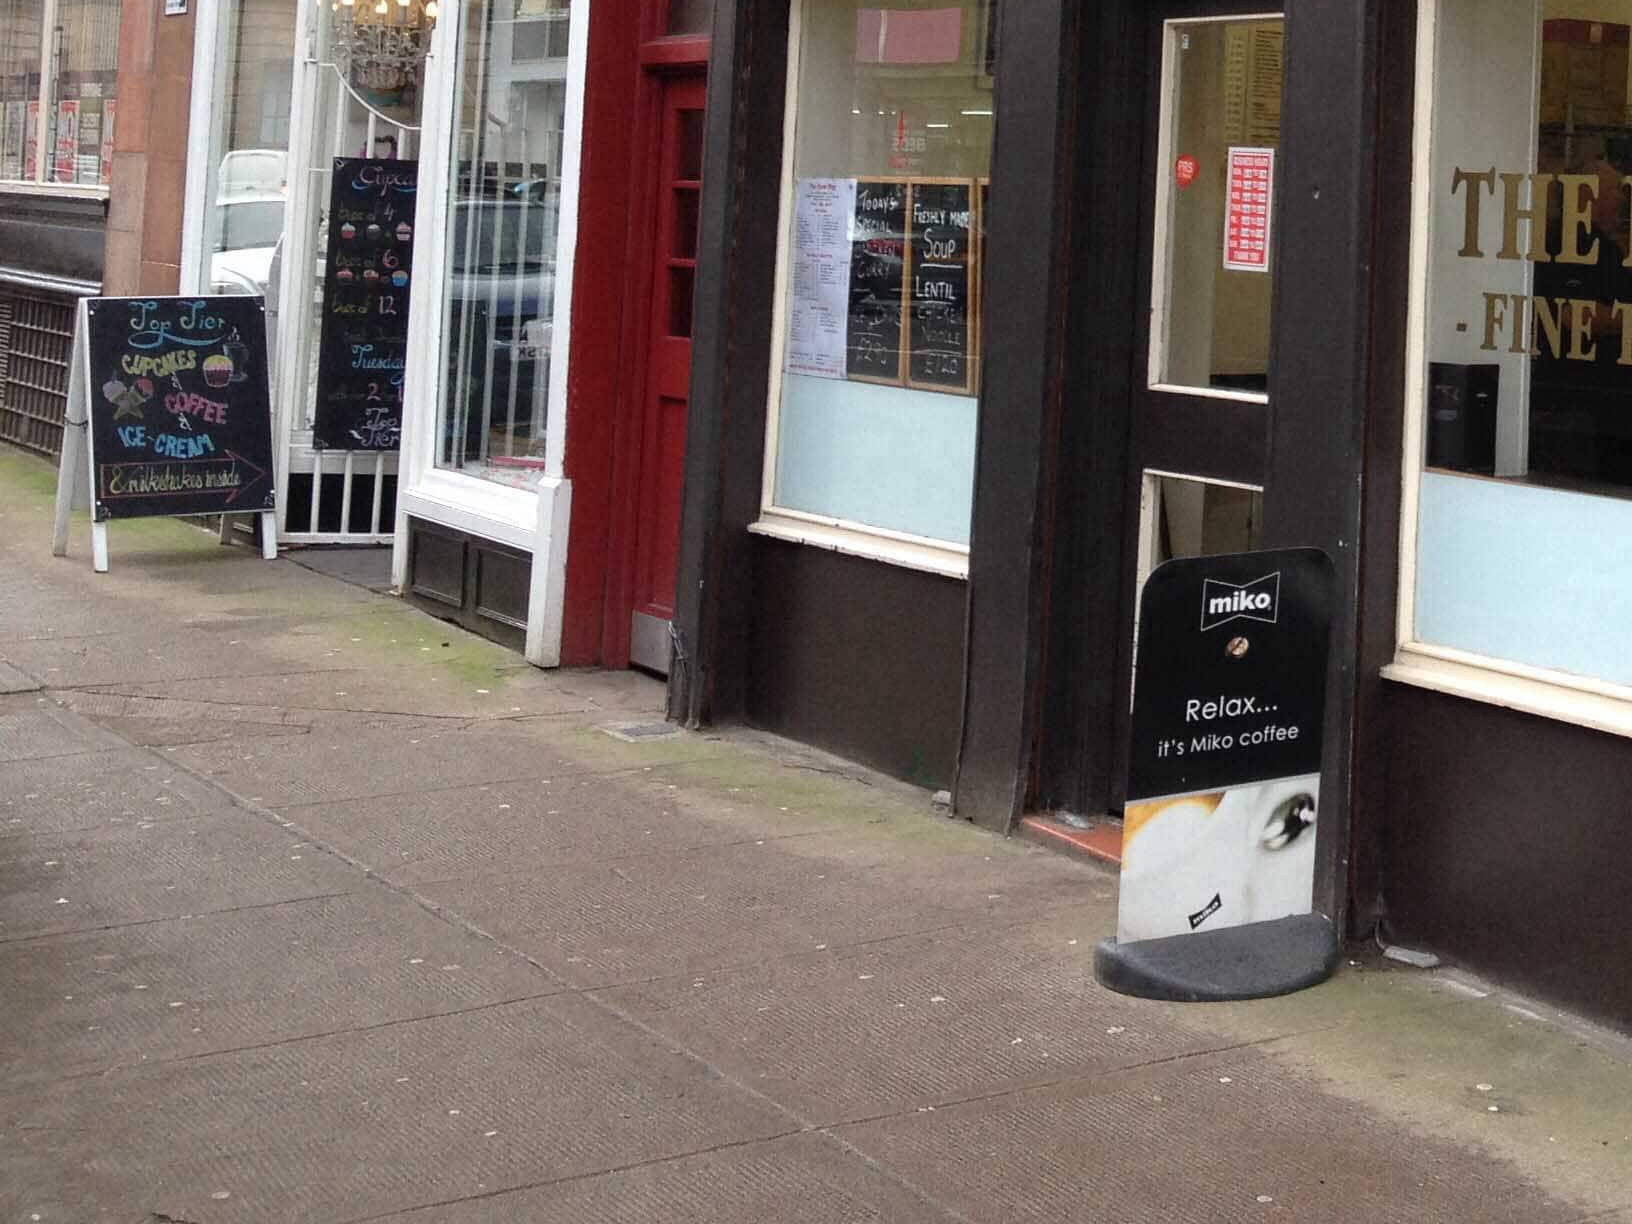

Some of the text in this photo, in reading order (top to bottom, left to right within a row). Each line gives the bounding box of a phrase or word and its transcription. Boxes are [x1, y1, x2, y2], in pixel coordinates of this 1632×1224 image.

[384, 202, 396, 222] 4
[913, 203, 948, 225] FRESHLY
[1451, 166, 1600, 265] THE
[923, 227, 956, 259] SOUP
[382, 248, 399, 269] 6
[915, 275, 957, 300] LENTIL
[378, 295, 398, 315] 12
[128, 300, 226, 339] Top Tier
[1480, 291, 1598, 361] FINE
[121, 349, 199, 377] CUPCAKES
[367, 382, 381, 401] 2
[163, 391, 229, 425] COFFEE
[1209, 590, 1272, 615] miko
[1186, 695, 1278, 723] Relax...
[1157, 724, 1300, 758] it's Miko coffee
